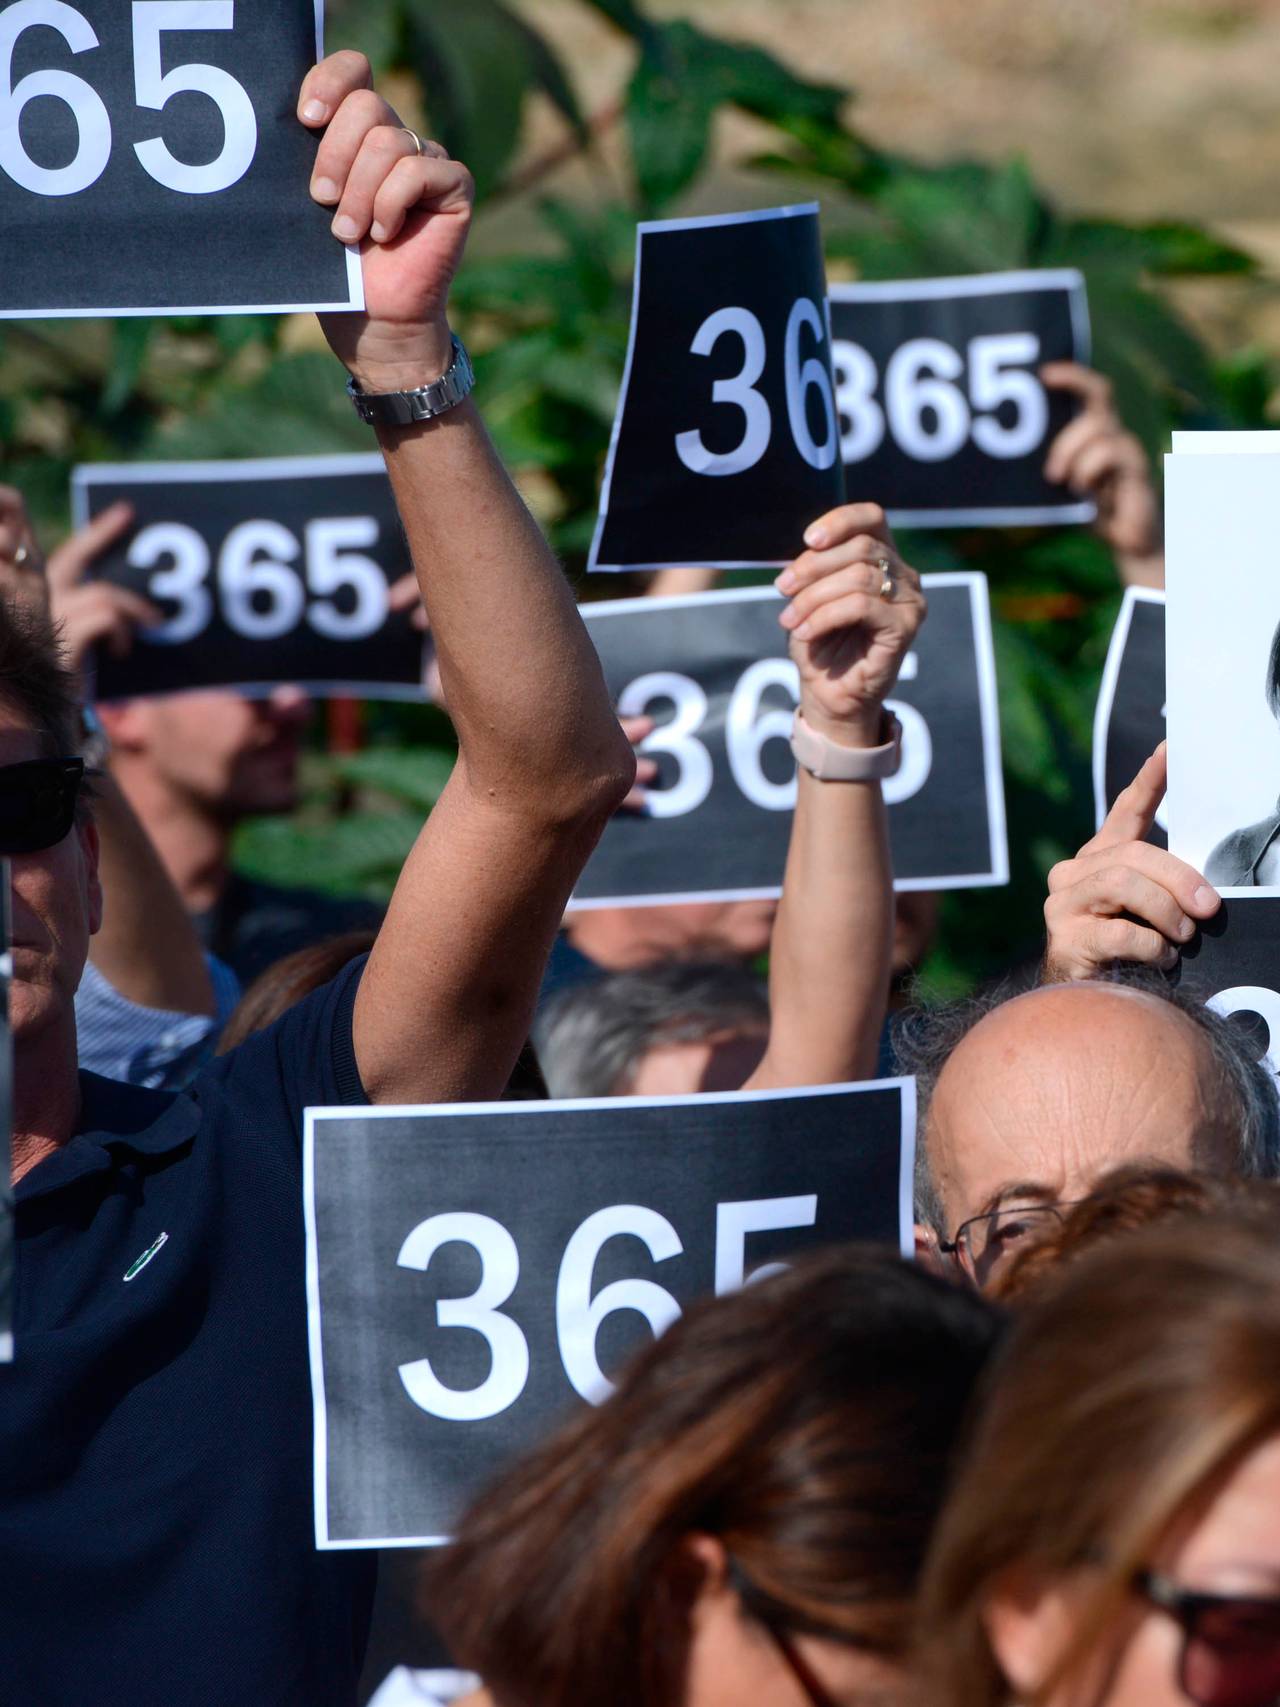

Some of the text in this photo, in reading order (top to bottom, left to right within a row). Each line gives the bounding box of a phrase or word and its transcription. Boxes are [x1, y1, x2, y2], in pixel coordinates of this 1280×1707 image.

[0, 0, 258, 197] 65
[675, 296, 836, 475] 36
[126, 515, 389, 645] 365
